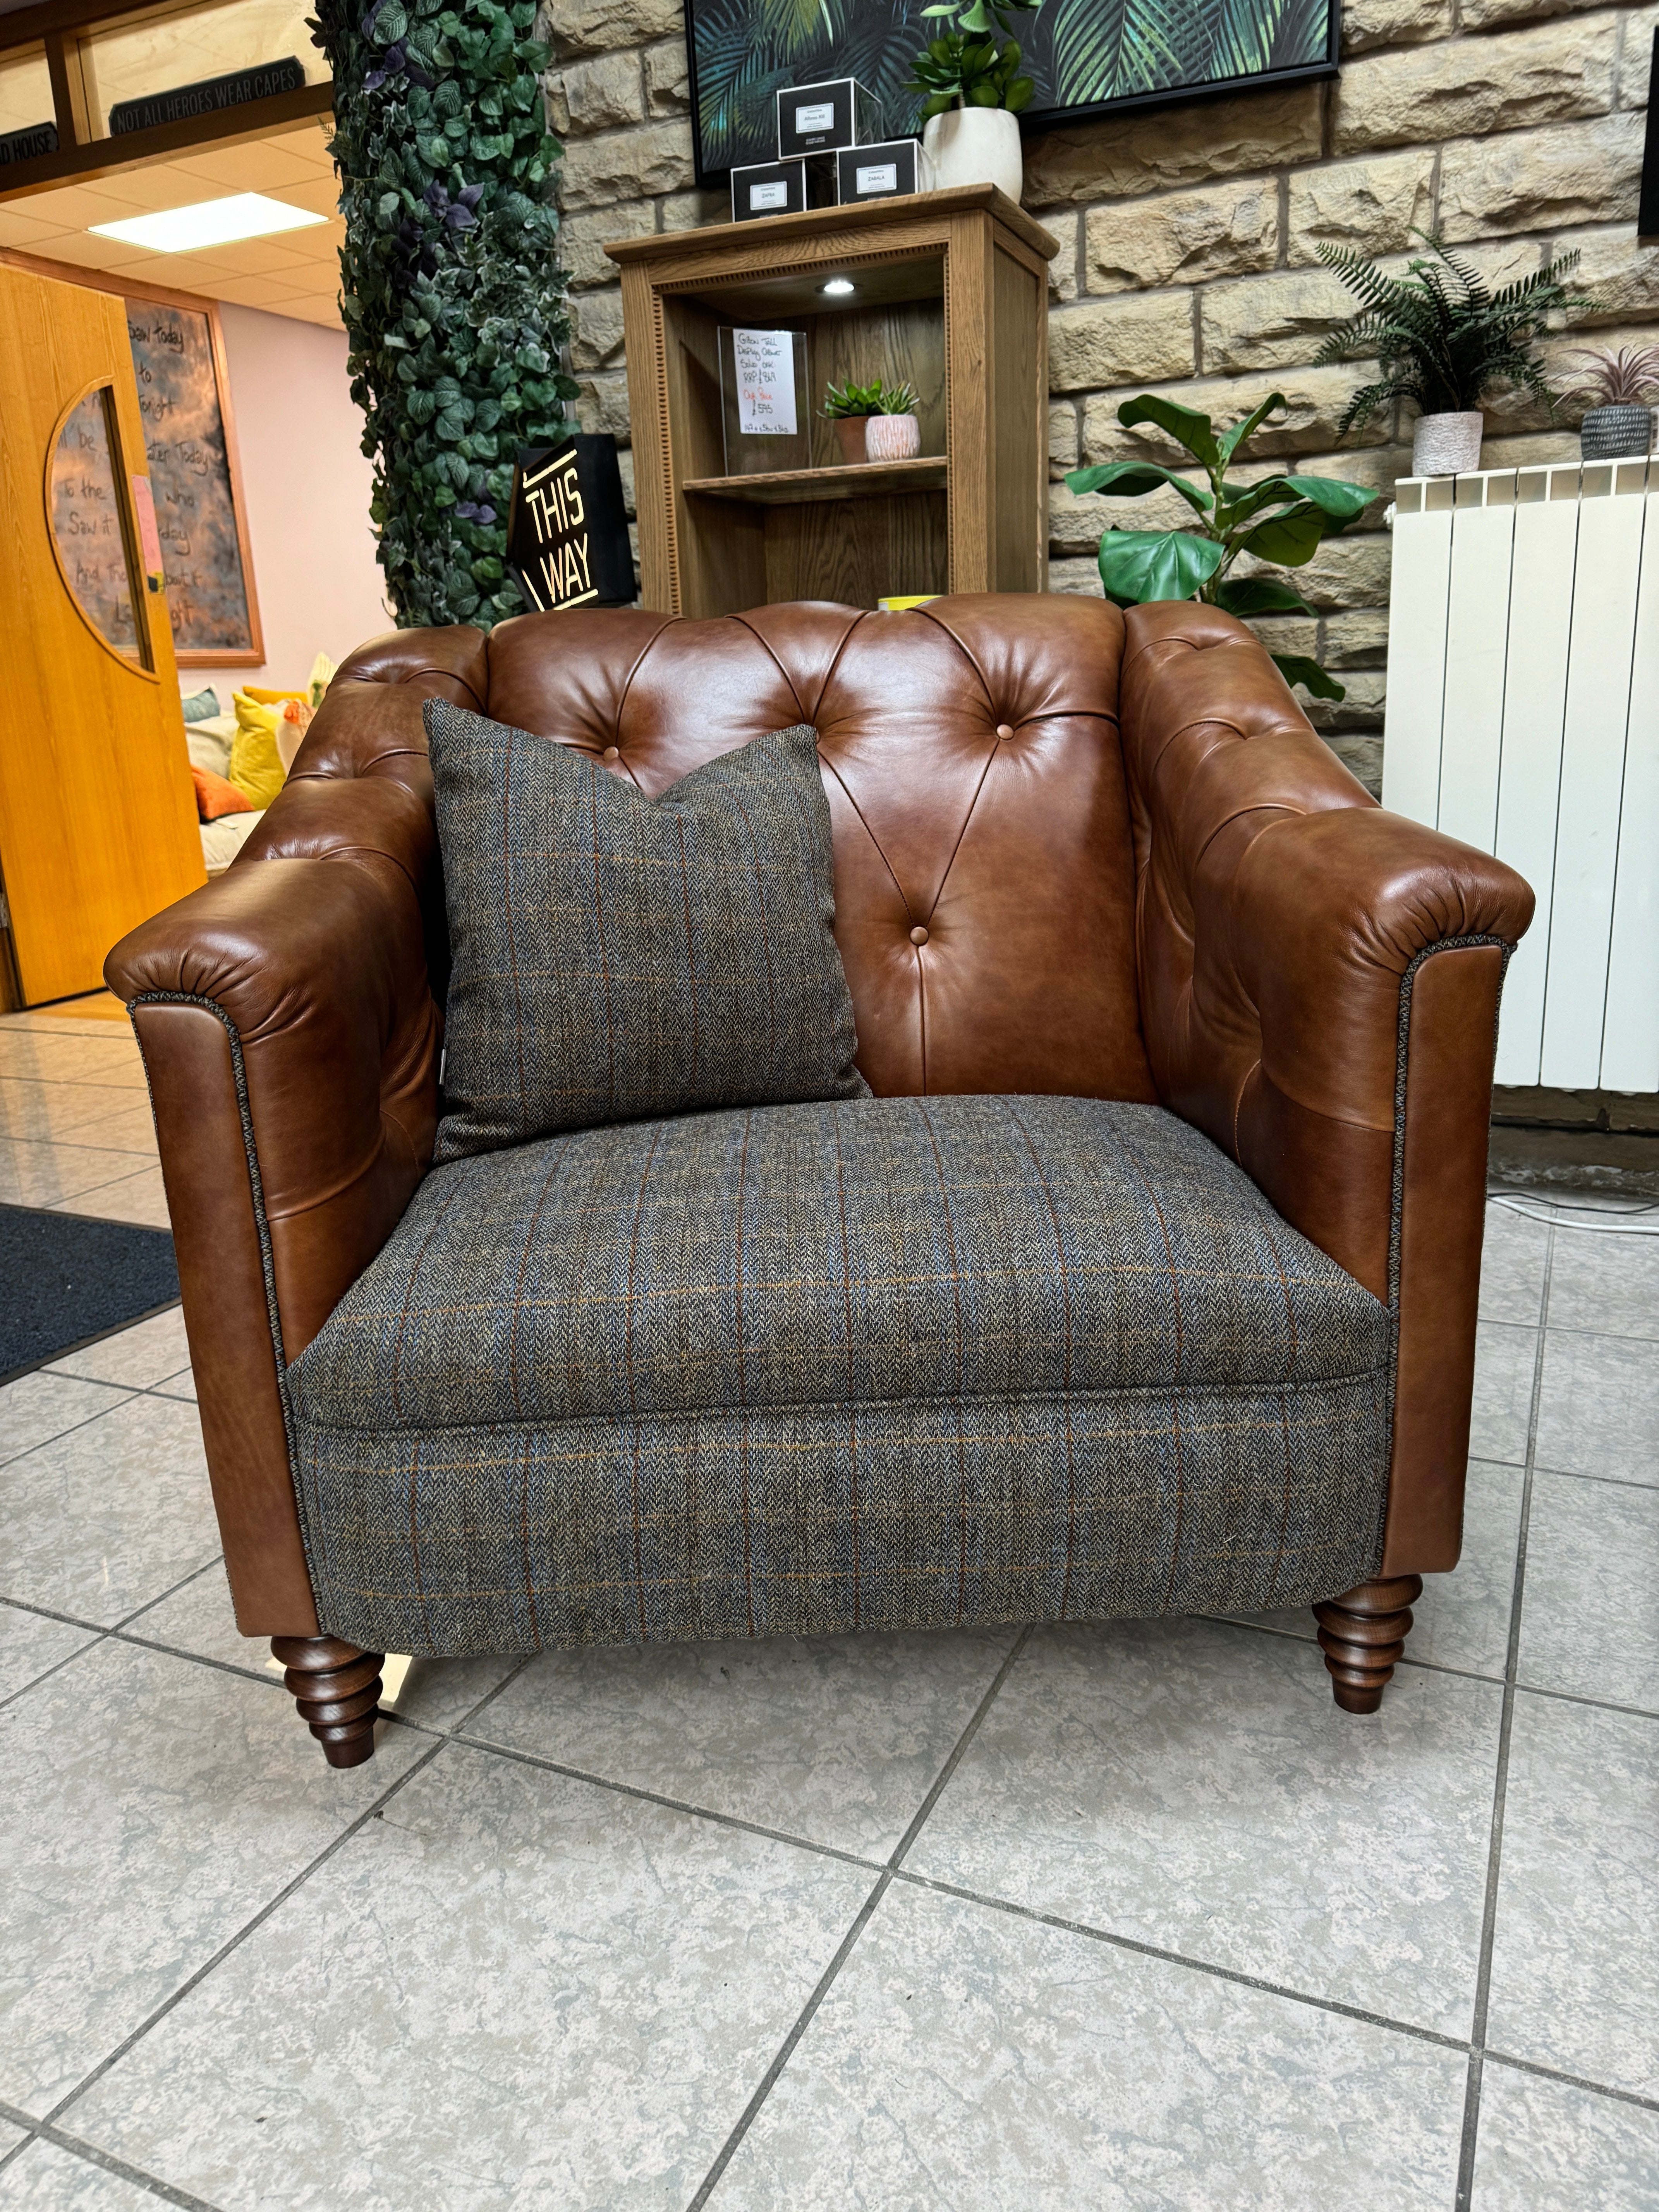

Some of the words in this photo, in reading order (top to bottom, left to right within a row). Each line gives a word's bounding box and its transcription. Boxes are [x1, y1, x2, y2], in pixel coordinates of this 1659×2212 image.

[117, 108, 140, 134] NOT
[144, 103, 165, 127] ALL
[167, 89, 213, 121] HEROES
[215, 79, 252, 108] WEAR
[254, 67, 295, 98] CAPES
[12, 131, 52, 161] HOUSE
[525, 467, 584, 544] THIS
[539, 532, 591, 604] WAY
